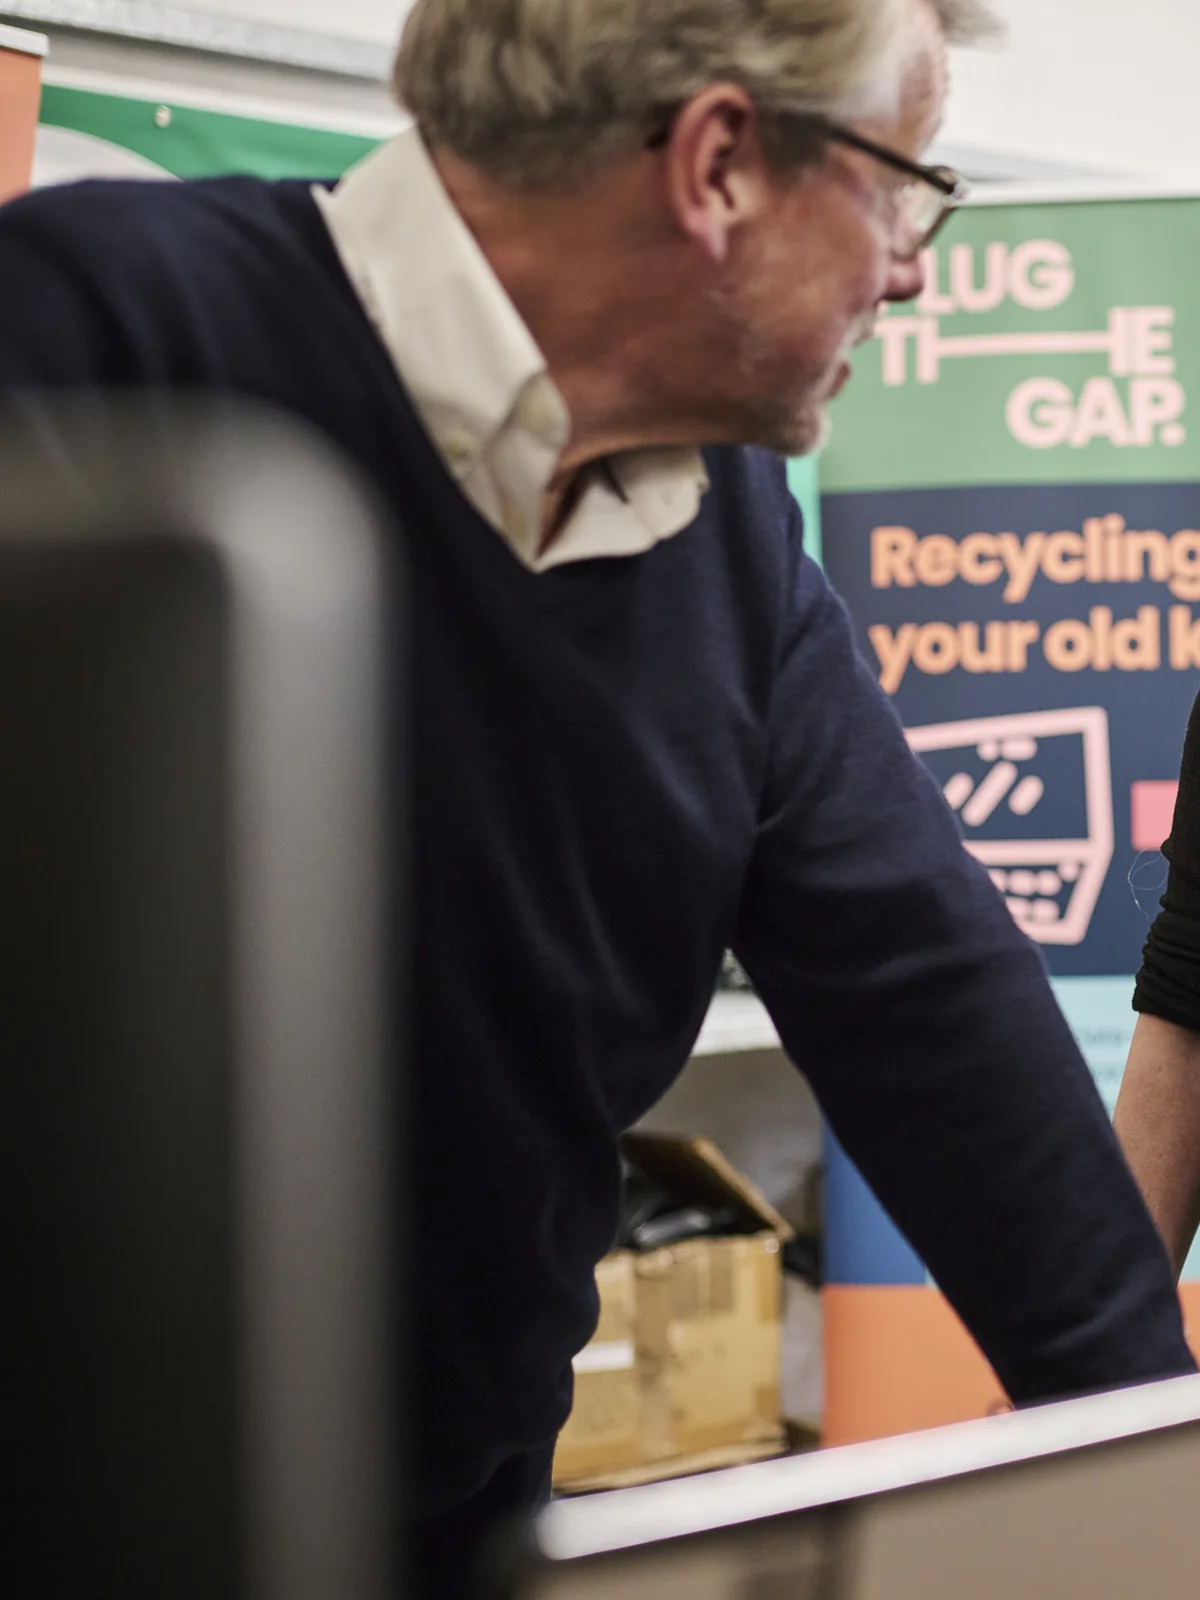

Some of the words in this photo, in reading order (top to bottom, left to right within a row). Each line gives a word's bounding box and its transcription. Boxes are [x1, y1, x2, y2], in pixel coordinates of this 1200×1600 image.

[877, 239, 1074, 314] LUG
[874, 307, 1174, 386] THE
[1006, 377, 1186, 448] GAP.
[868, 617, 1038, 696] your
[1043, 606, 1160, 672] old
